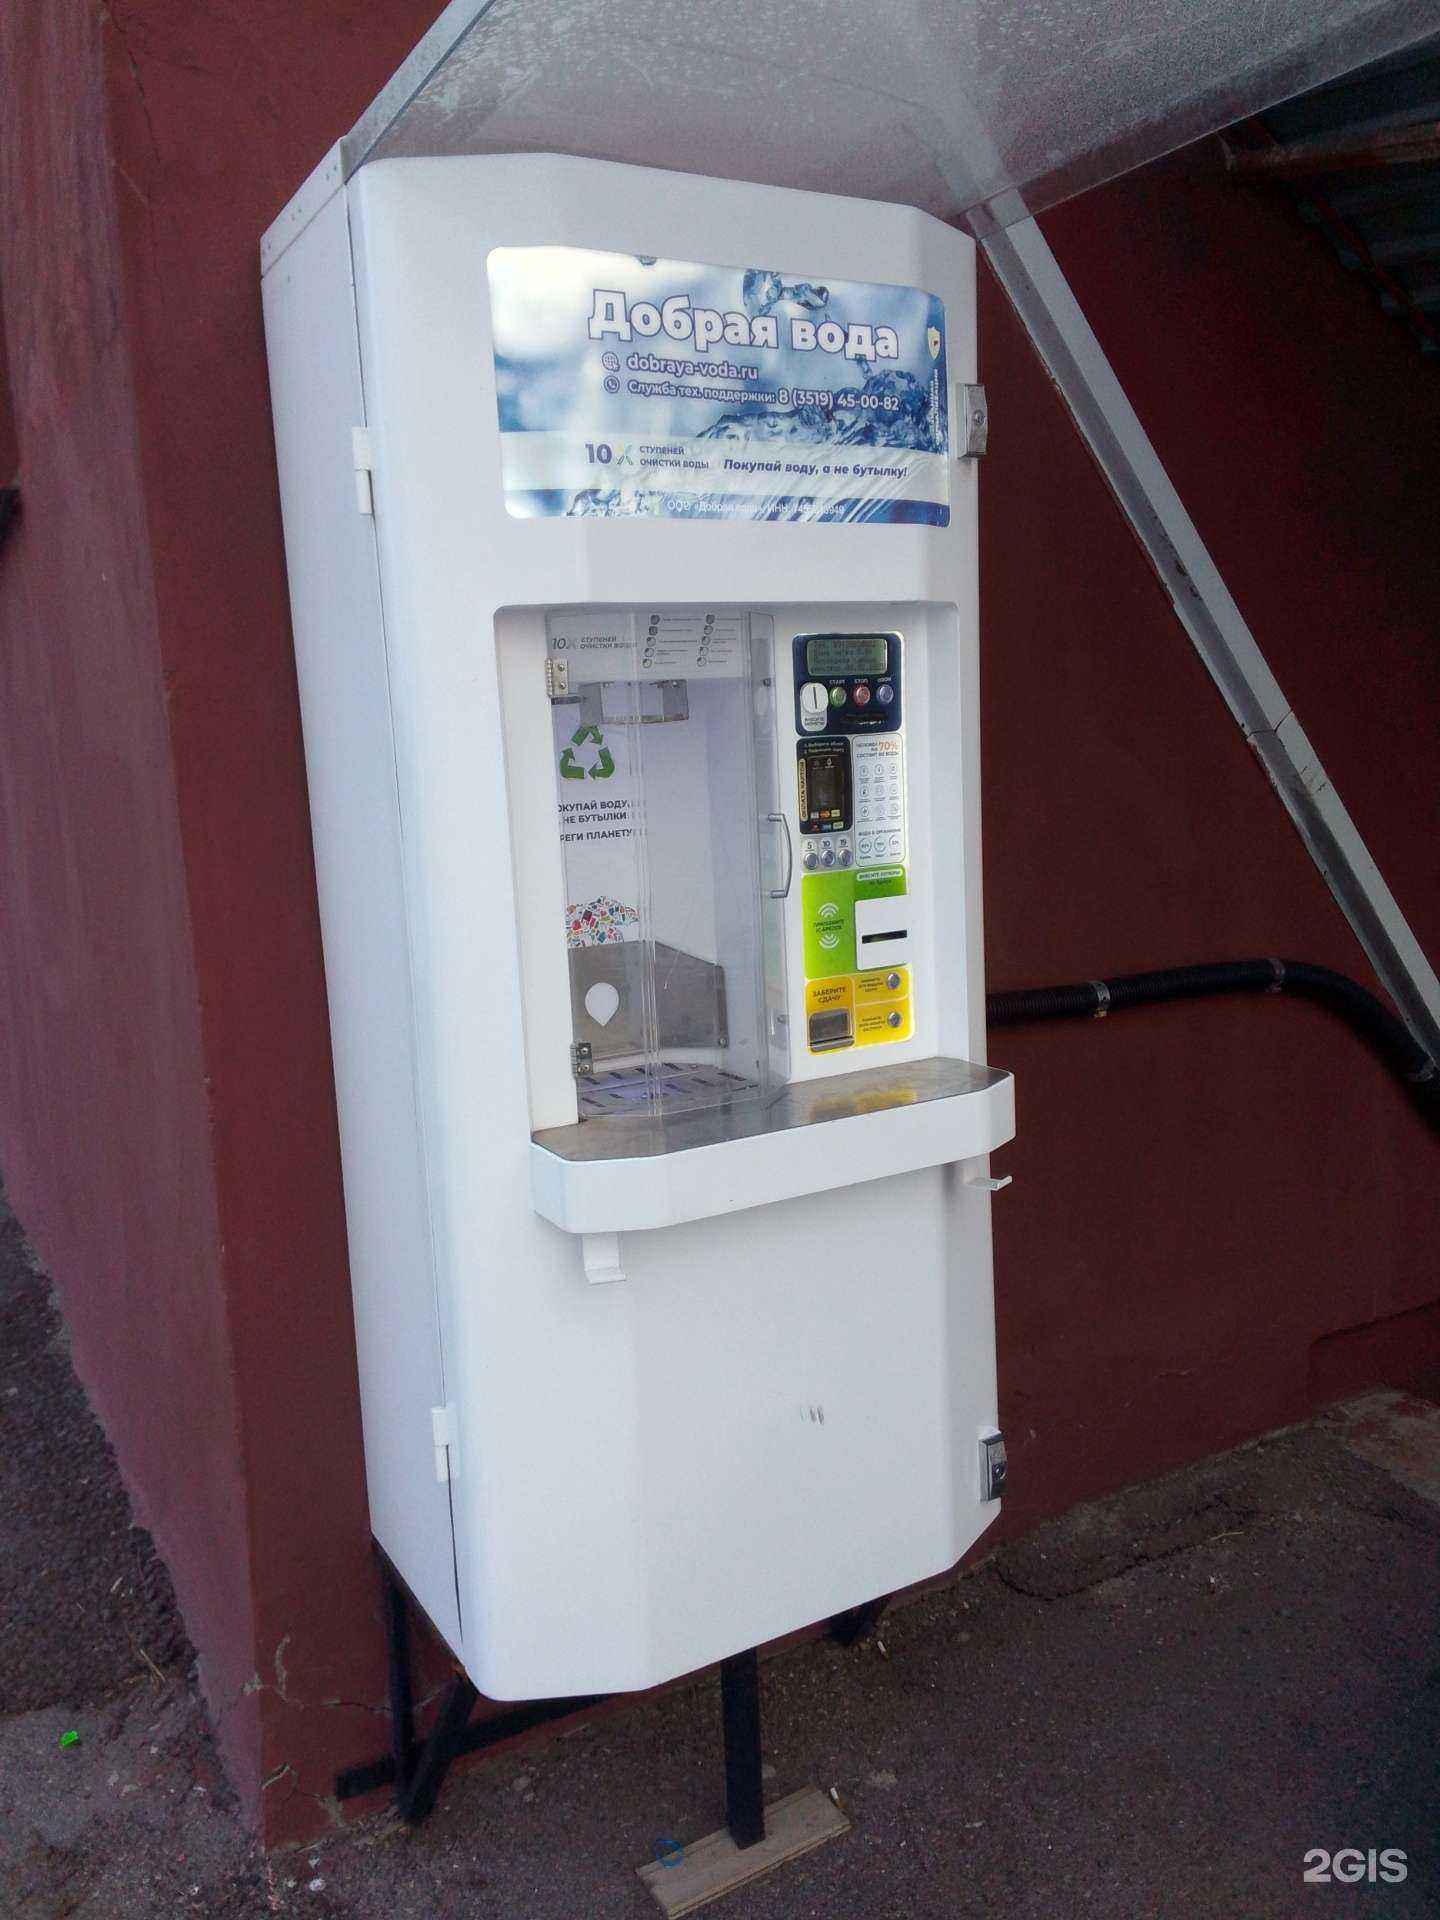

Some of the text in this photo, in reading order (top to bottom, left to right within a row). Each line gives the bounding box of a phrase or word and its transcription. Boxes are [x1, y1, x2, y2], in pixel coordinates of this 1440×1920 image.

[588, 289, 899, 362] Добрая вода
[626, 353, 759, 379] dobraya-voda.ru
[627, 379, 900, 411] Служба тех. поддержки: 8 (3519) 45-00-82
[585, 442, 613, 464] 10
[639, 445, 685, 455] СТУПЕНЕЙ
[639, 458, 709, 469] ОЧИСТКИ ВОДЫ
[723, 458, 907, 478] Покупай воду, а не бутылку!
[578, 811, 627, 823] БУТЫЛКИ
